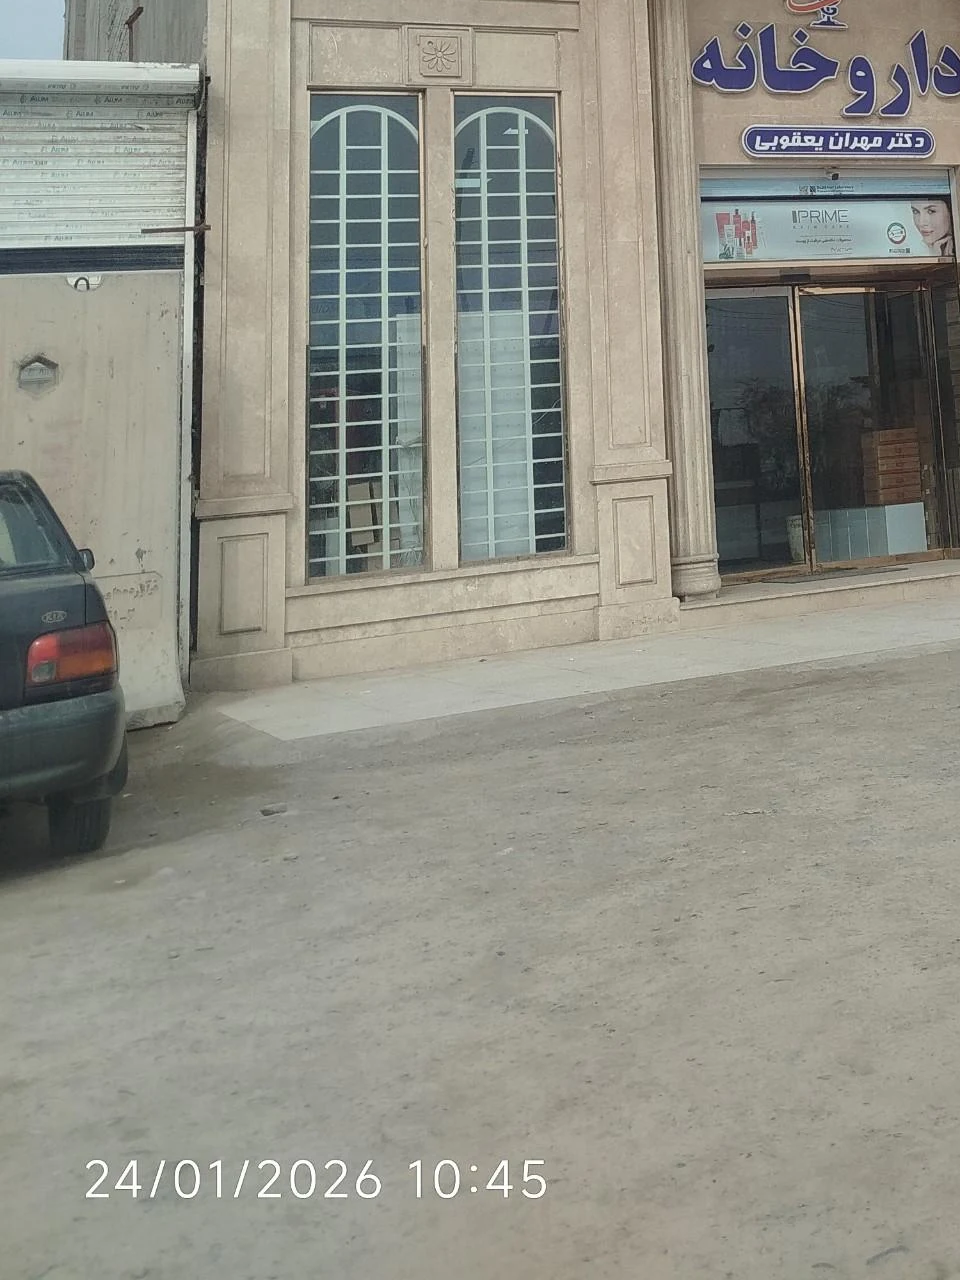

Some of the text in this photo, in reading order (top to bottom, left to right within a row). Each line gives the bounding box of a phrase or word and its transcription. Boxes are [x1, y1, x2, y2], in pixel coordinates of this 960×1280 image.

[754, 131, 925, 151] دکتر مهران یعقوبی
[797, 210, 849, 224] PRIME
